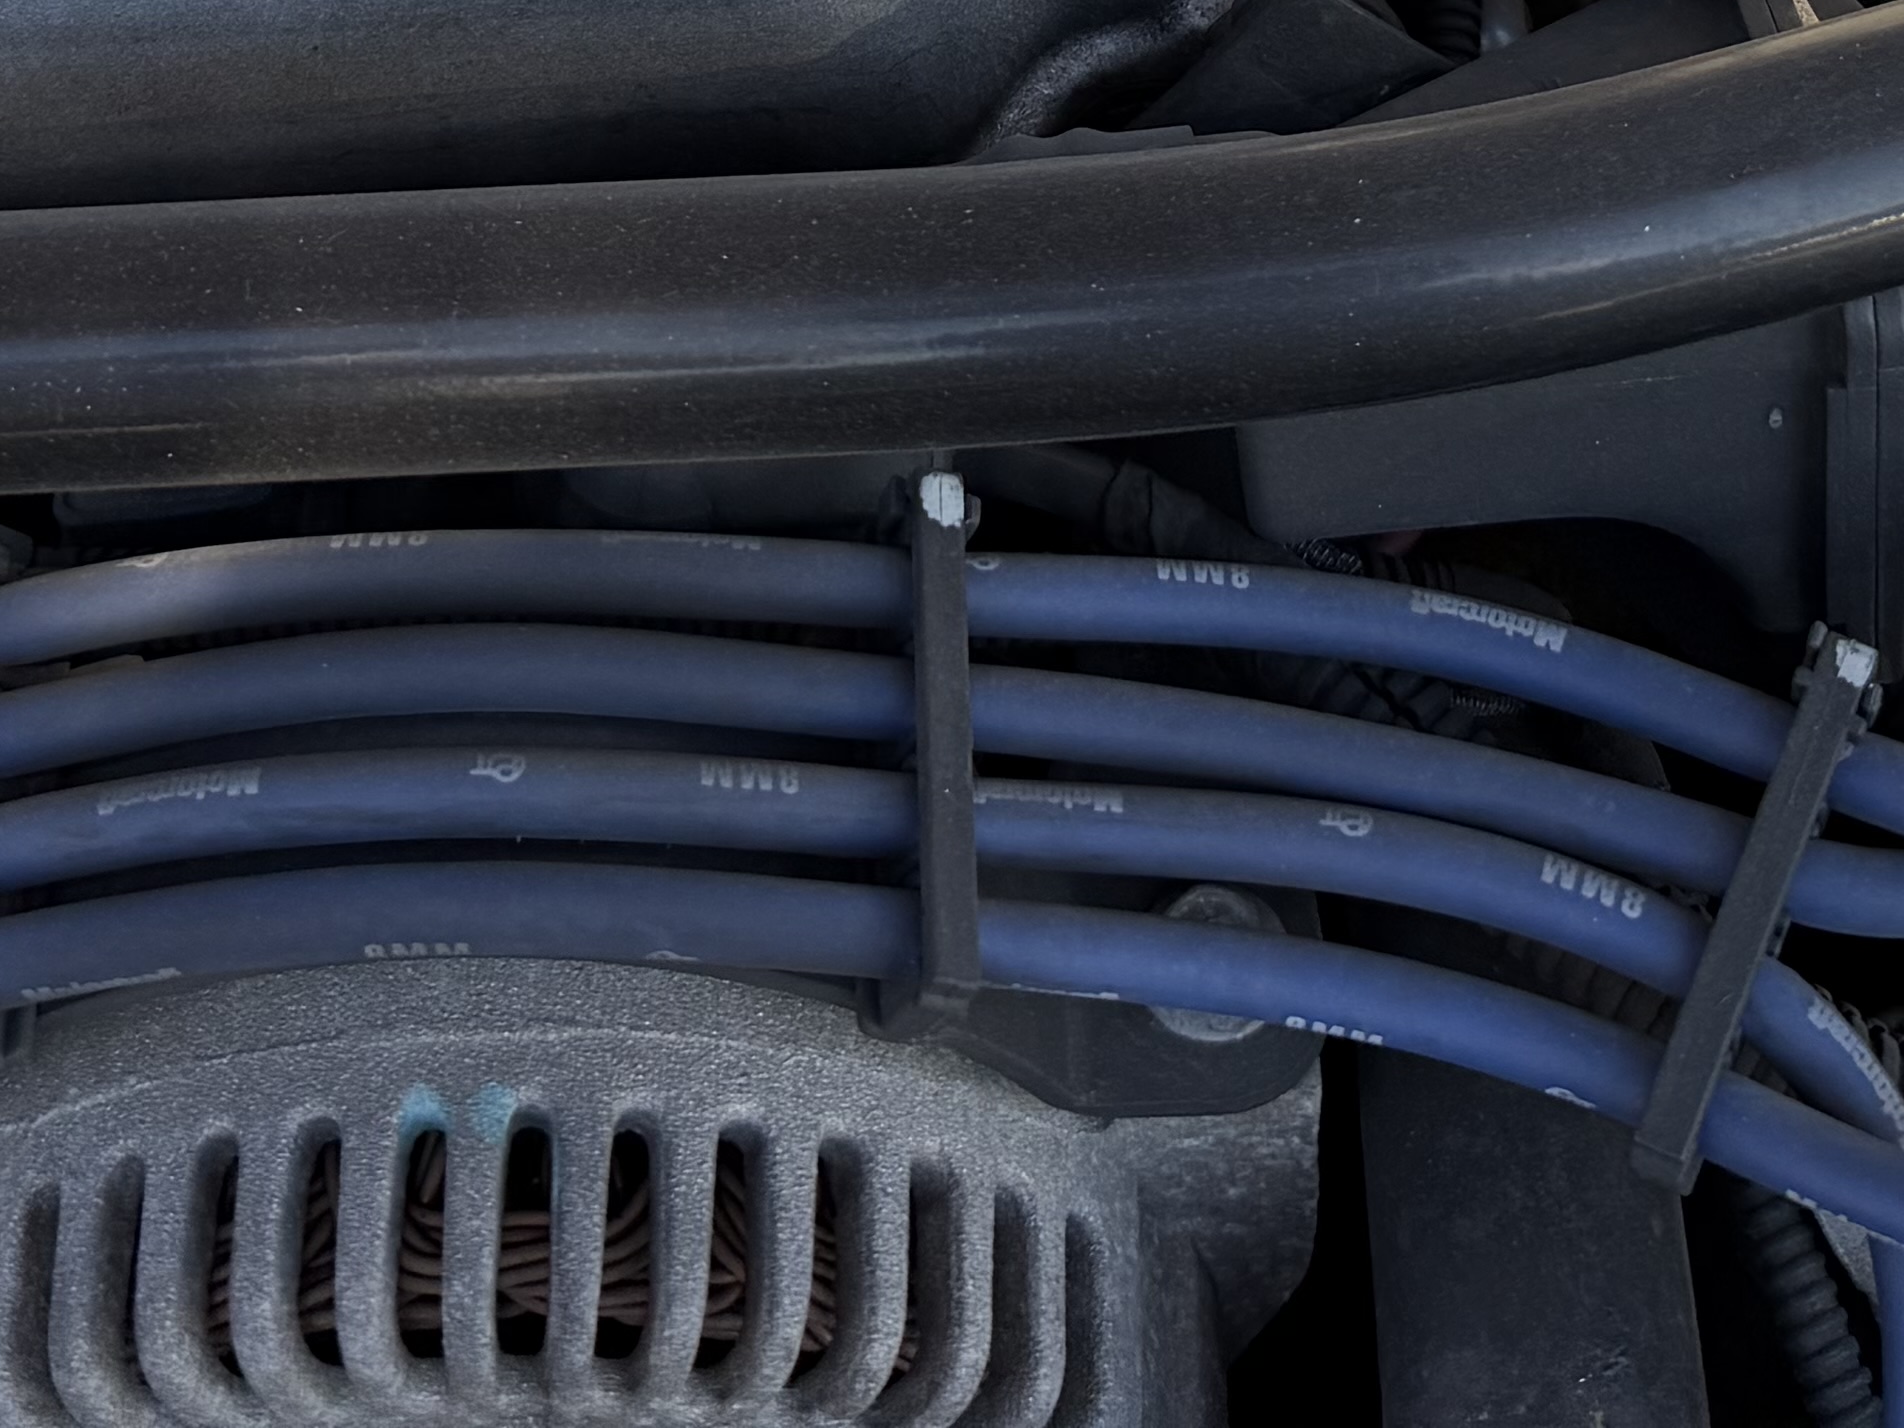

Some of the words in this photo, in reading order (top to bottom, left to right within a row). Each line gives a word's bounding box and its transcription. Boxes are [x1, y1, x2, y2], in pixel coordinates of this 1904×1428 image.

[1156, 557, 1252, 590] 8MM
[1409, 587, 1572, 654] Motorcraft
[699, 761, 802, 796] 8MM
[1540, 853, 1649, 920] 8MM
